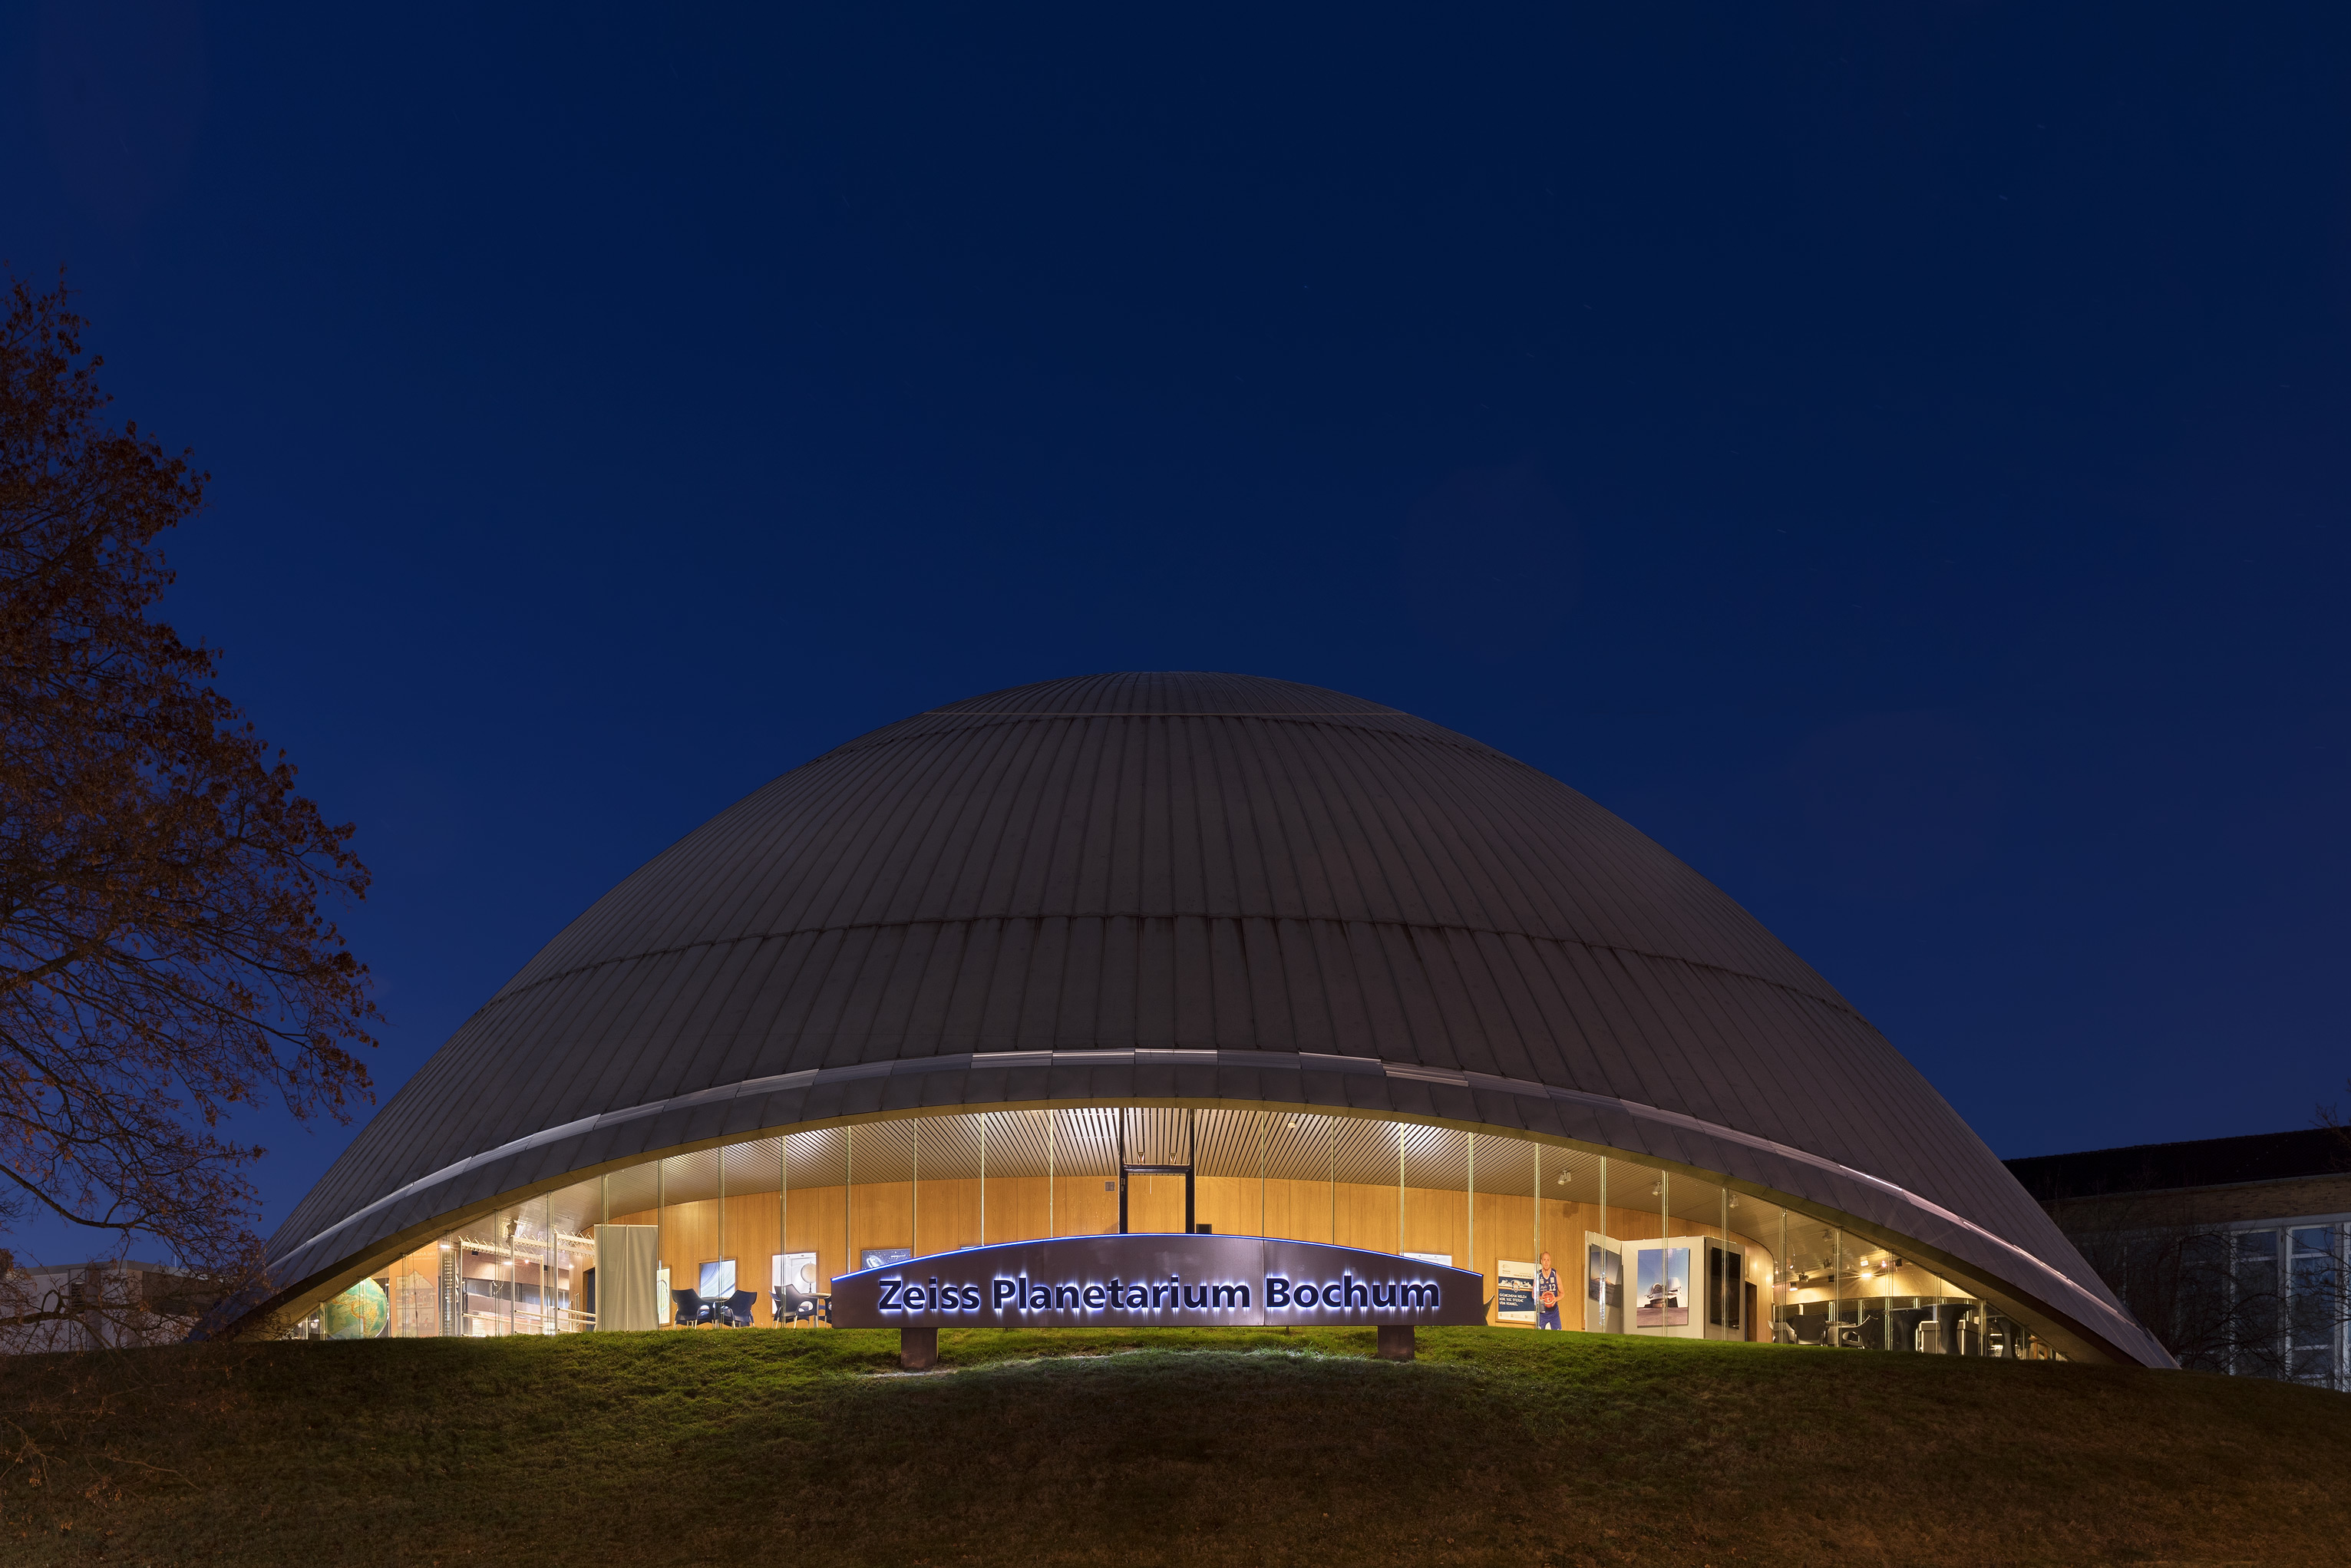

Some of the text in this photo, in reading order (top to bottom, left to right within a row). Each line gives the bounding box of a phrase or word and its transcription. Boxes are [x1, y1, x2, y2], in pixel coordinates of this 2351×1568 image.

[879, 1275, 1440, 1309] Zeiss Planetarium Bochum
